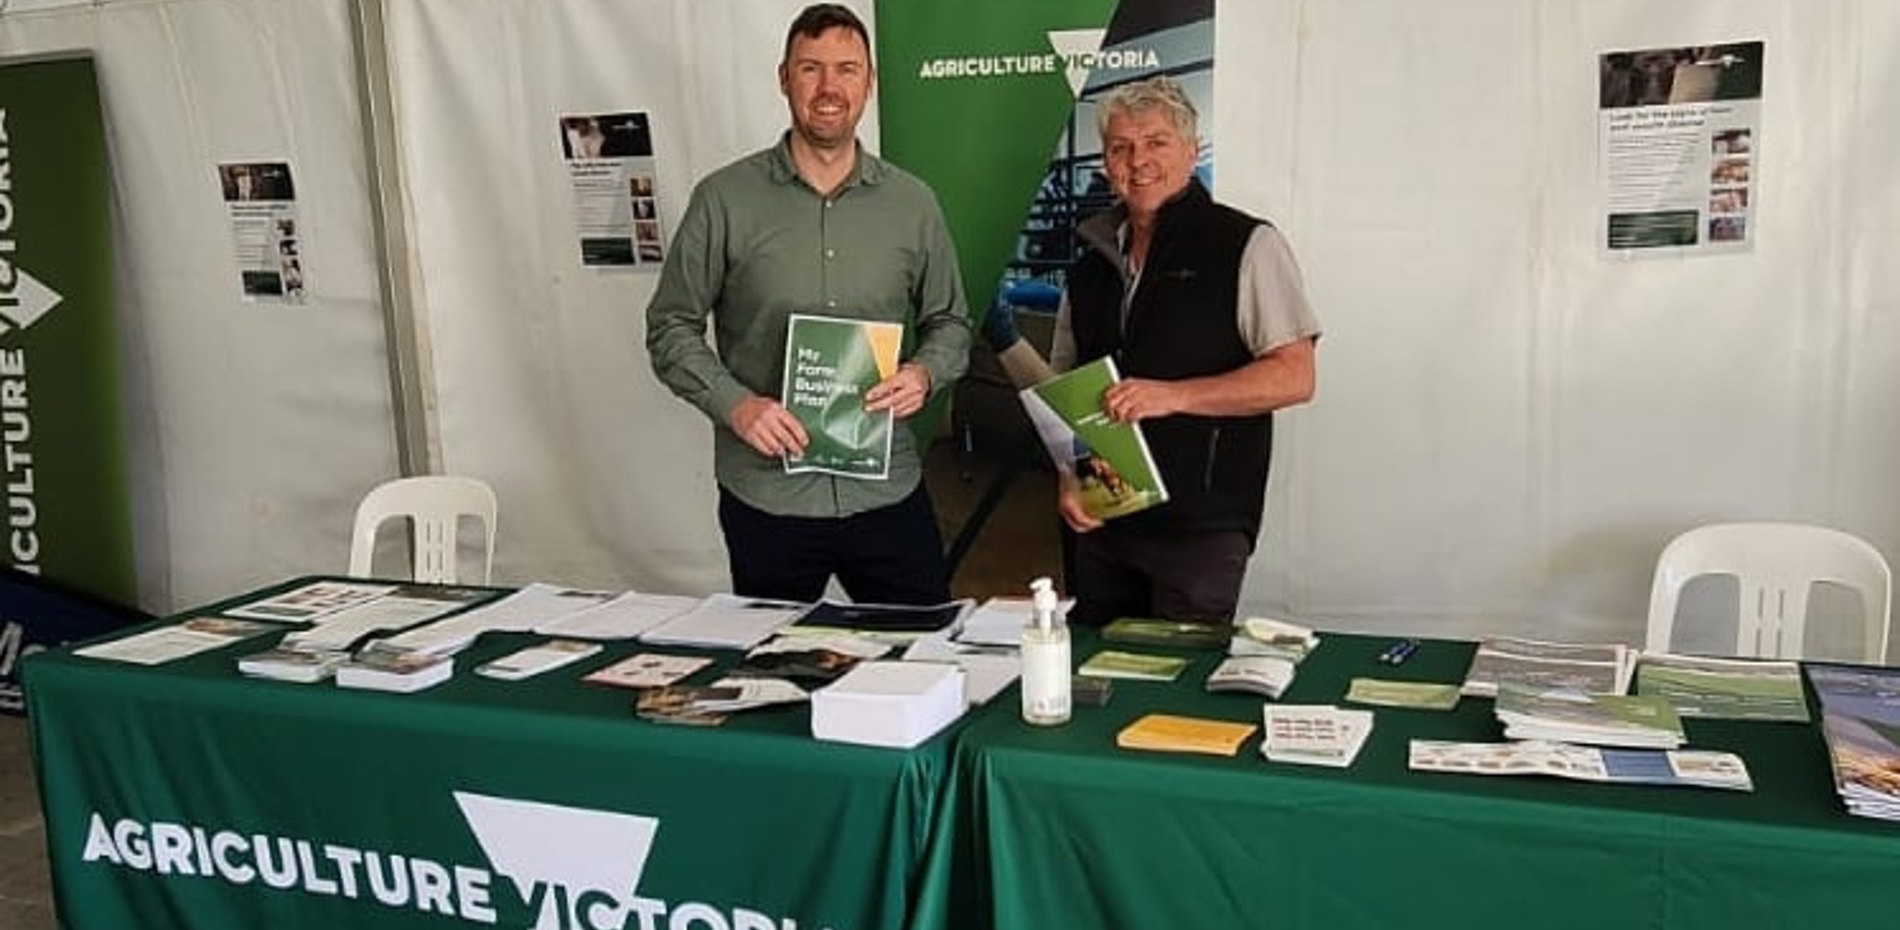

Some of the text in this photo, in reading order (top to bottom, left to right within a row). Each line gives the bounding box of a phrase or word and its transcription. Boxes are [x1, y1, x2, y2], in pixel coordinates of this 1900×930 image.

[920, 50, 1161, 78] AGRICULTURE VICTORIA
[83, 812, 497, 924] AGRICULTURE
